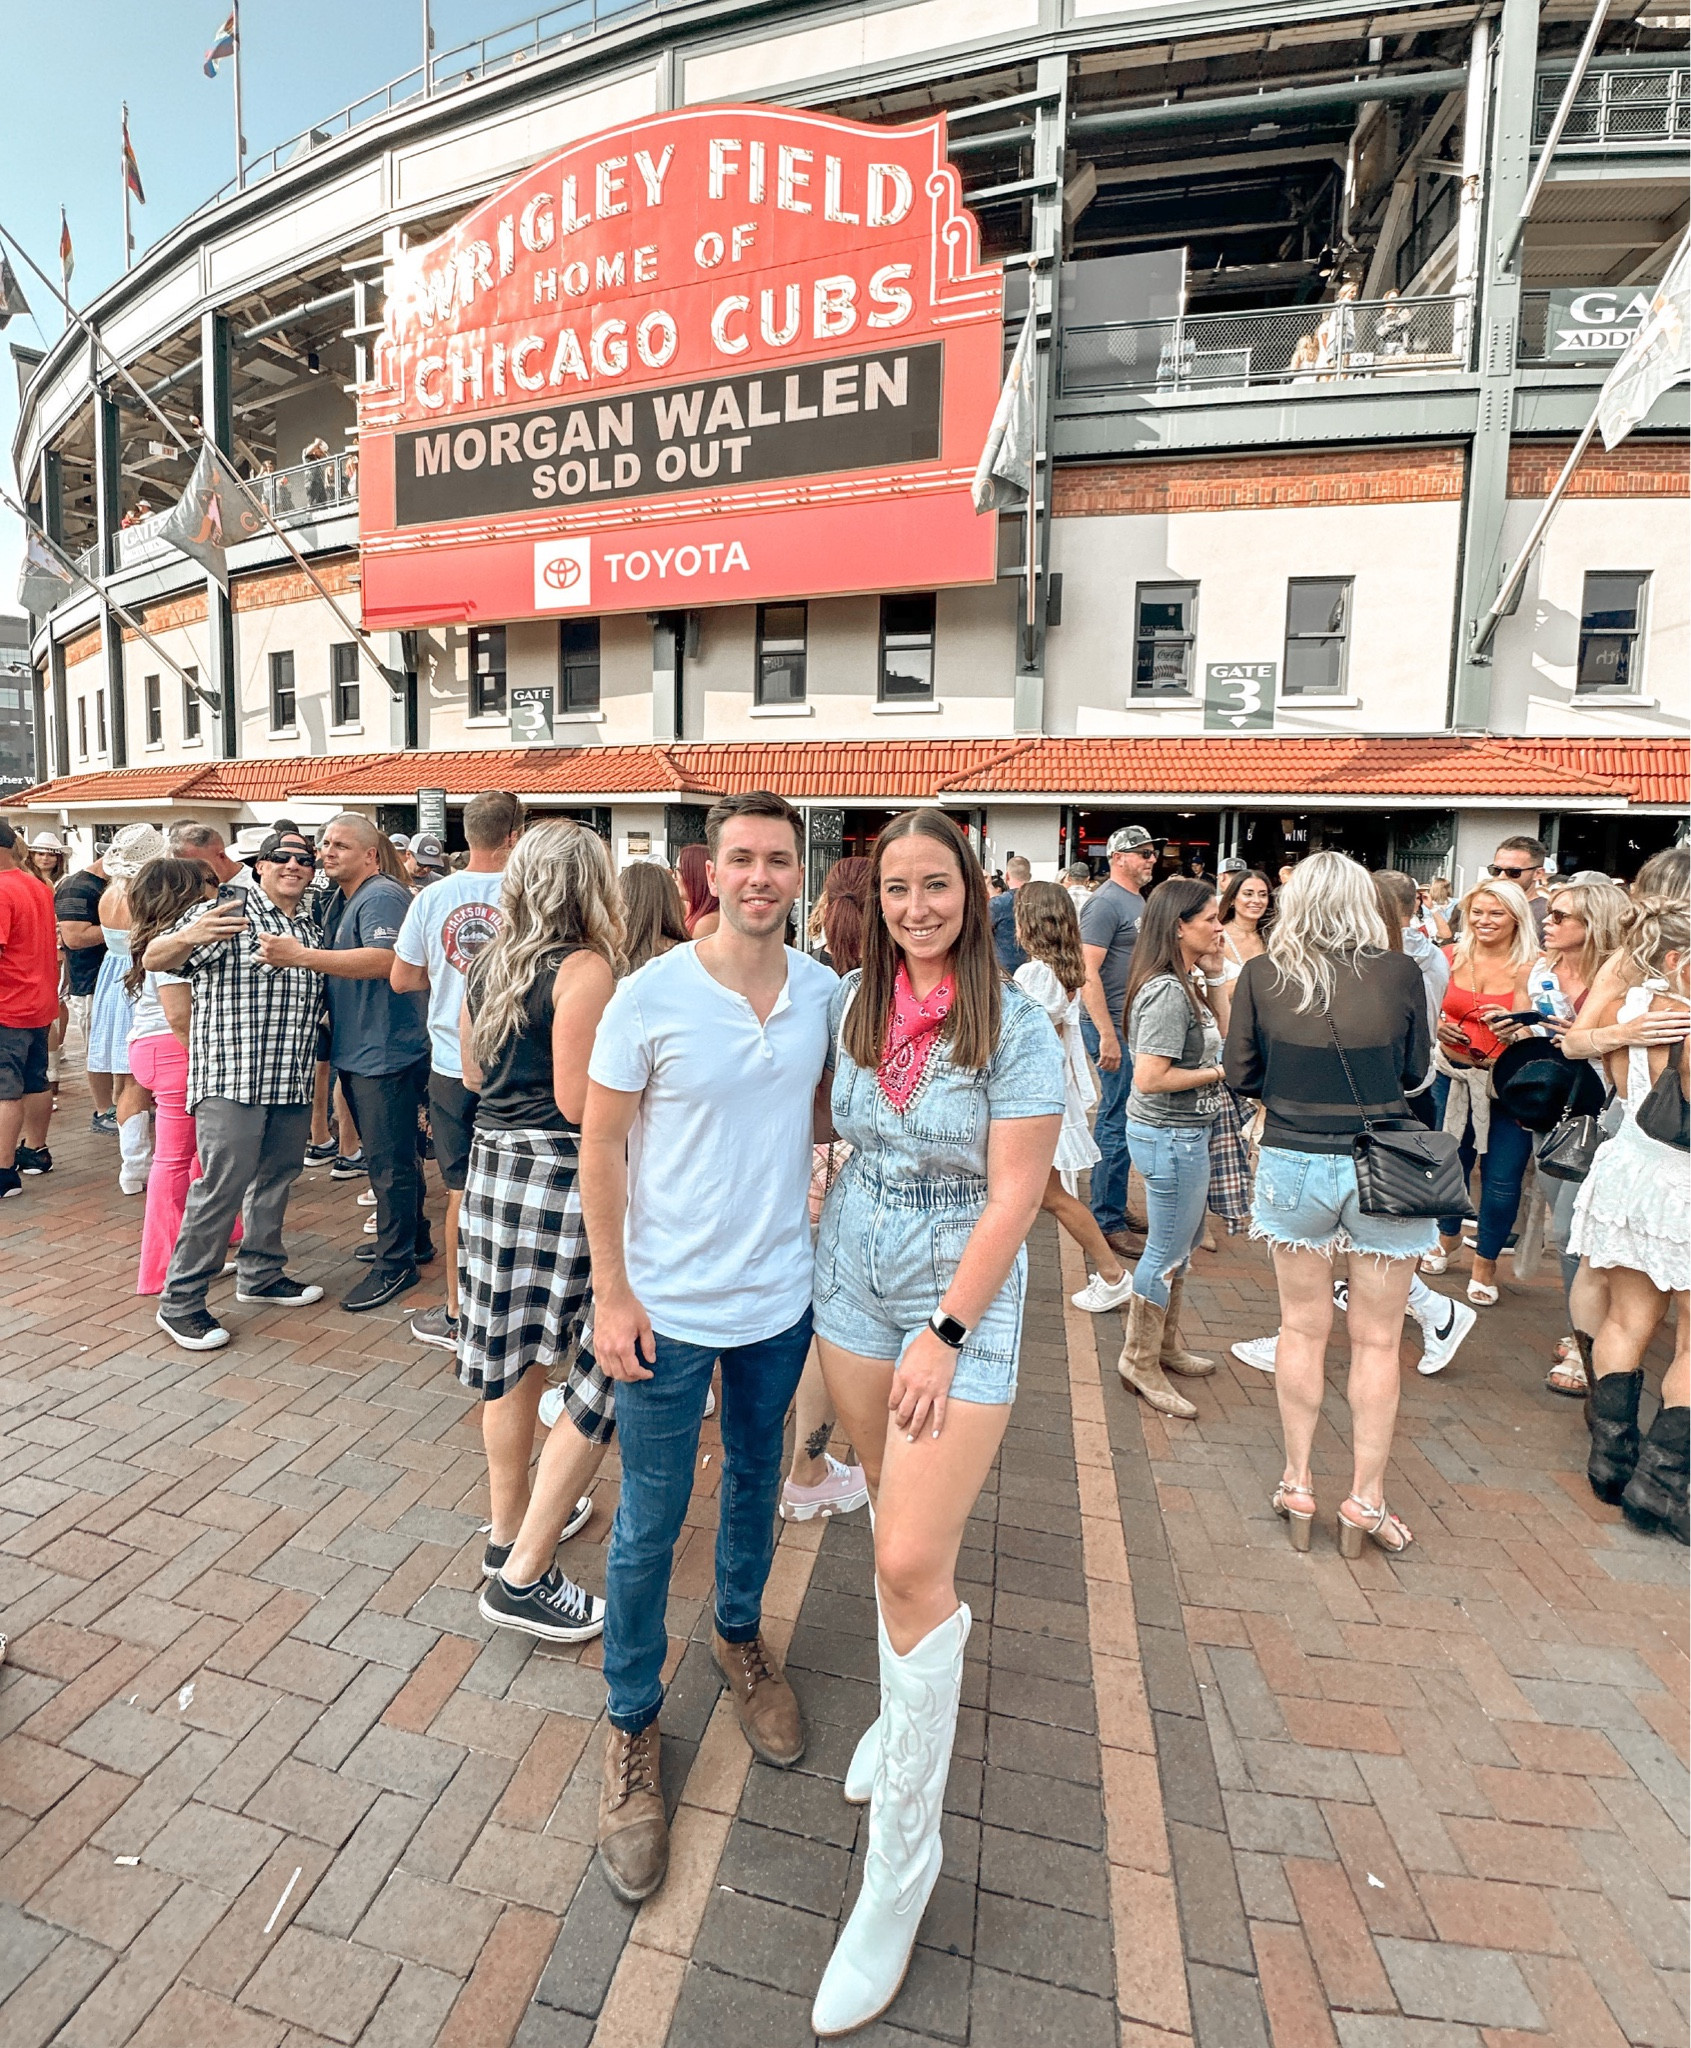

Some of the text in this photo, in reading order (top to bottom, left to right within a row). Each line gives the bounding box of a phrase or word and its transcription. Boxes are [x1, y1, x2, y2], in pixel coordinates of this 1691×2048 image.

[412, 138, 913, 328] WRIGLEY FIELD
[533, 222, 758, 305] HOME OF
[414, 263, 913, 410] CHICAGO CUBS
[414, 356, 909, 478] MORGAN WALLEN
[531, 436, 753, 500] SOLD OUT
[603, 541, 751, 583] TOYOTA
[1210, 665, 1272, 678] GATE
[513, 689, 551, 701] GATE
[517, 700, 546, 731] 3
[1216, 678, 1262, 716] 3
[446, 906, 488, 935] JACKSON
